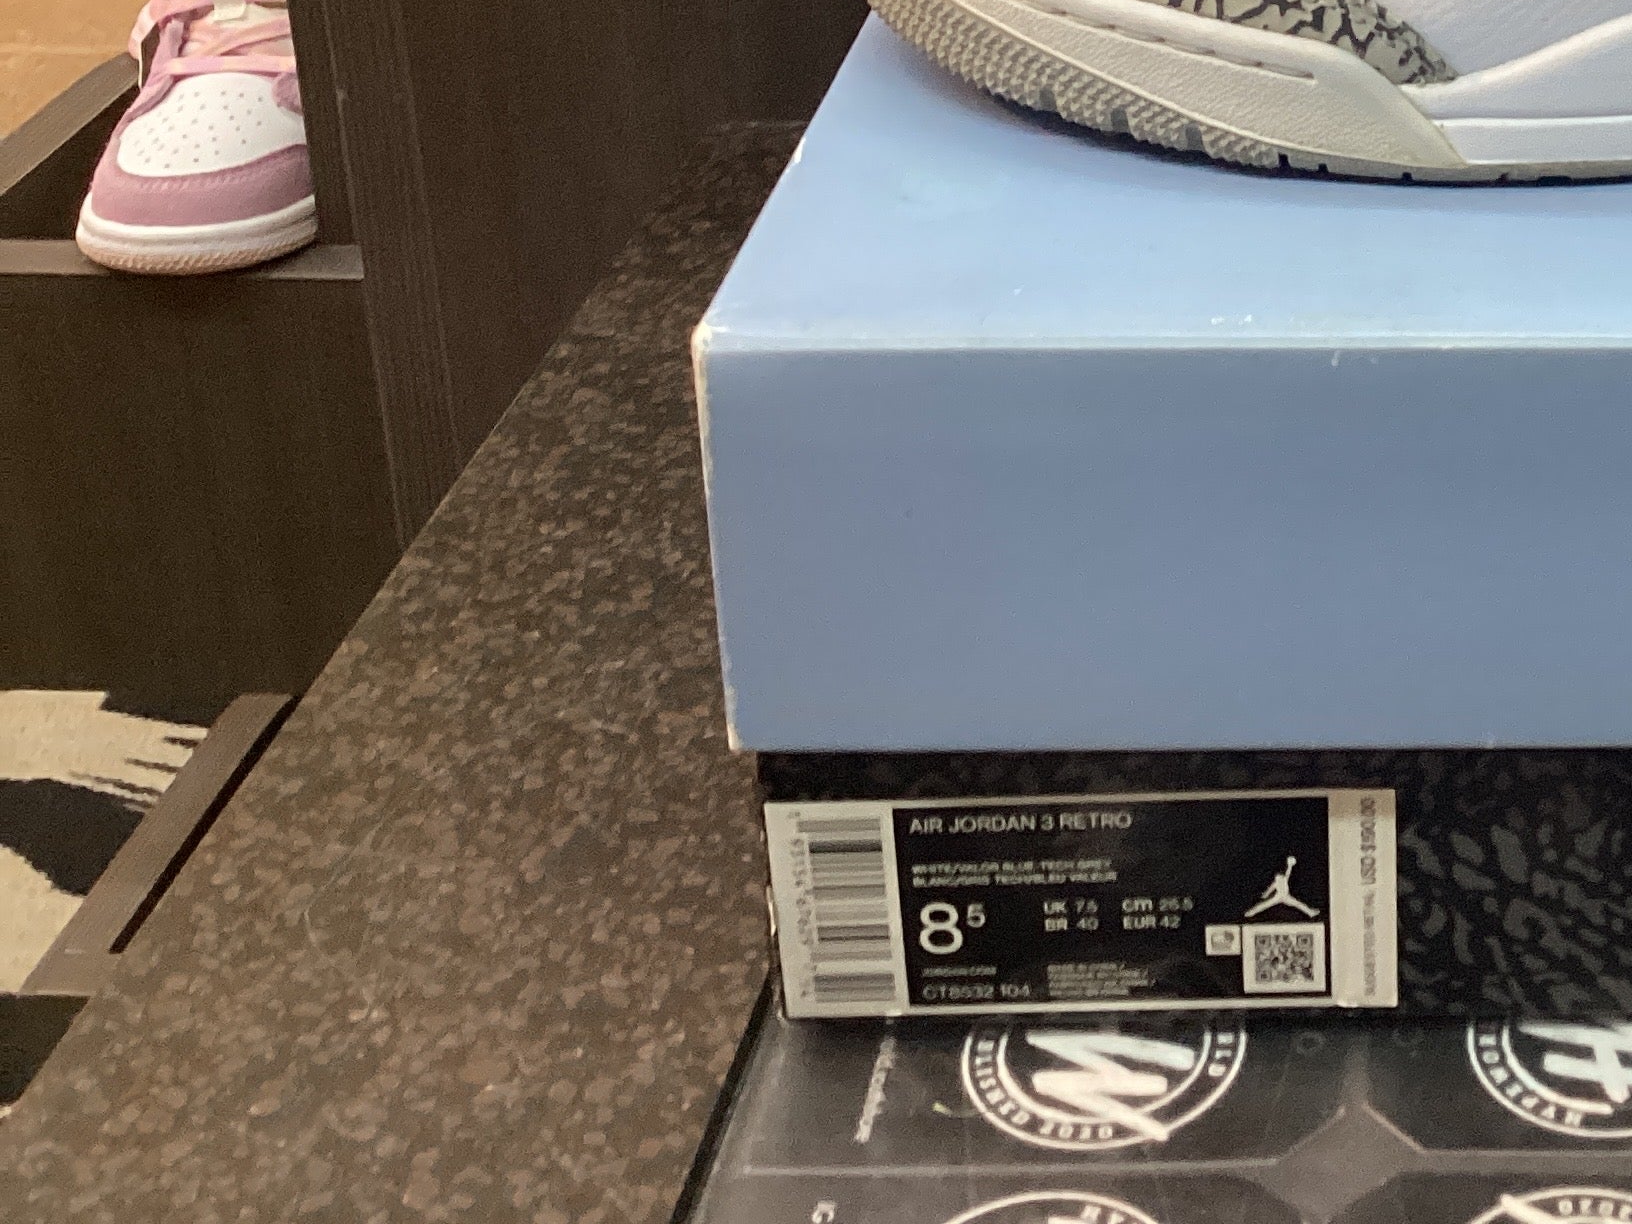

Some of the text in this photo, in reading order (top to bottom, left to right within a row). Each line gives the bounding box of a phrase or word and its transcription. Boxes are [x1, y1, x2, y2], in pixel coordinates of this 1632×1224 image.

[909, 811, 1133, 834] AIR JORDAN 3 RETRO
[919, 902, 963, 954] 8
